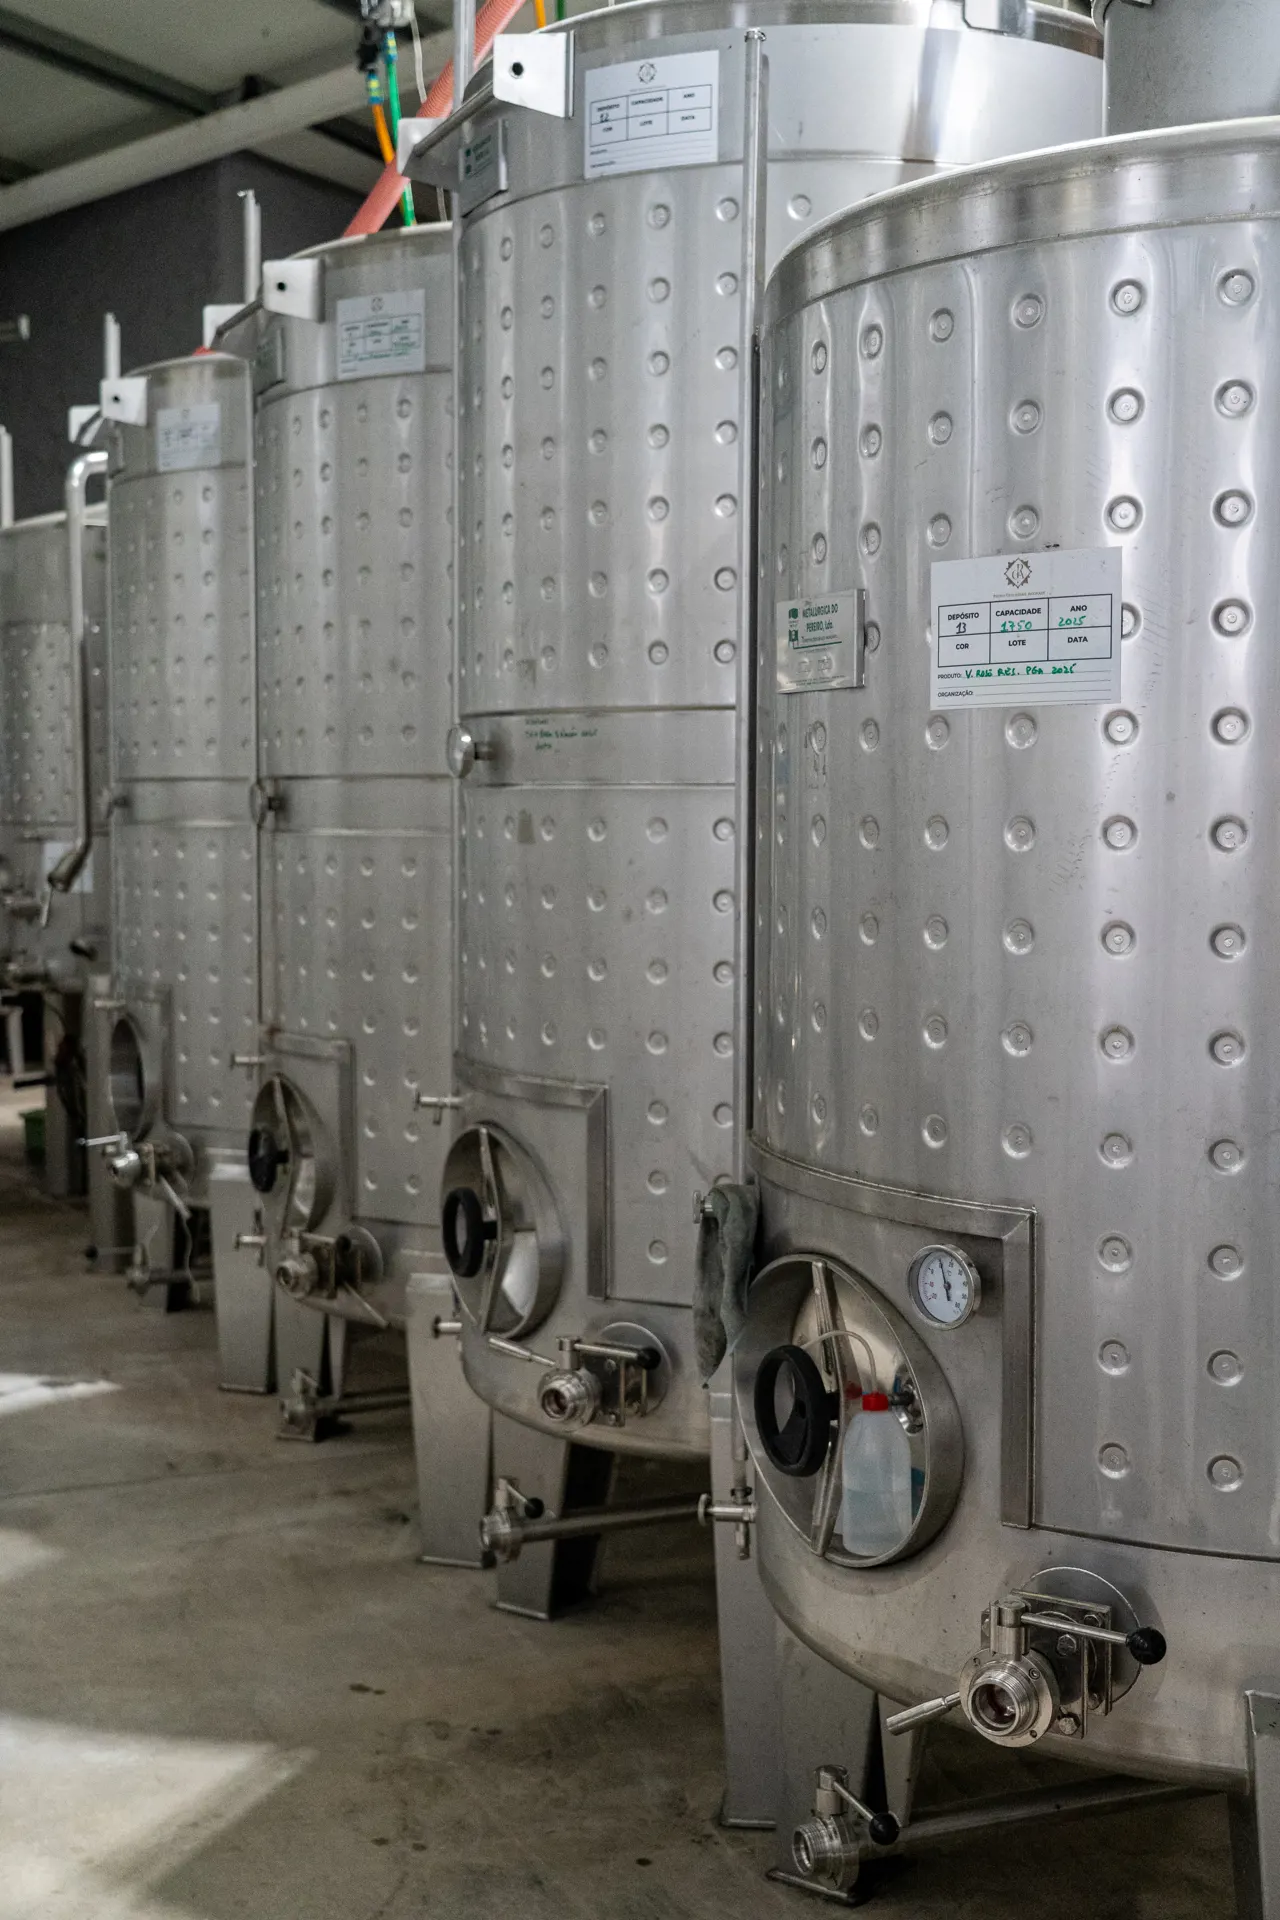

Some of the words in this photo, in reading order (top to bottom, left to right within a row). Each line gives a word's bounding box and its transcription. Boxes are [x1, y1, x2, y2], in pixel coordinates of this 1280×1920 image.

[831, 603, 838, 614] DO
[995, 607, 1042, 617] CAPACIDADE
[947, 611, 979, 621] DEPÓSITO
[1058, 615, 1087, 627] 2025
[955, 622, 967, 634] 13
[1000, 620, 1032, 633] 1750
[1008, 639, 1026, 647] LOTE
[1067, 636, 1088, 644] DATA
[1051, 663, 1077, 674] 2025
[937, 672, 962, 680] PRODUTO:
[937, 690, 974, 698] ORGANIZAÇÃO:
